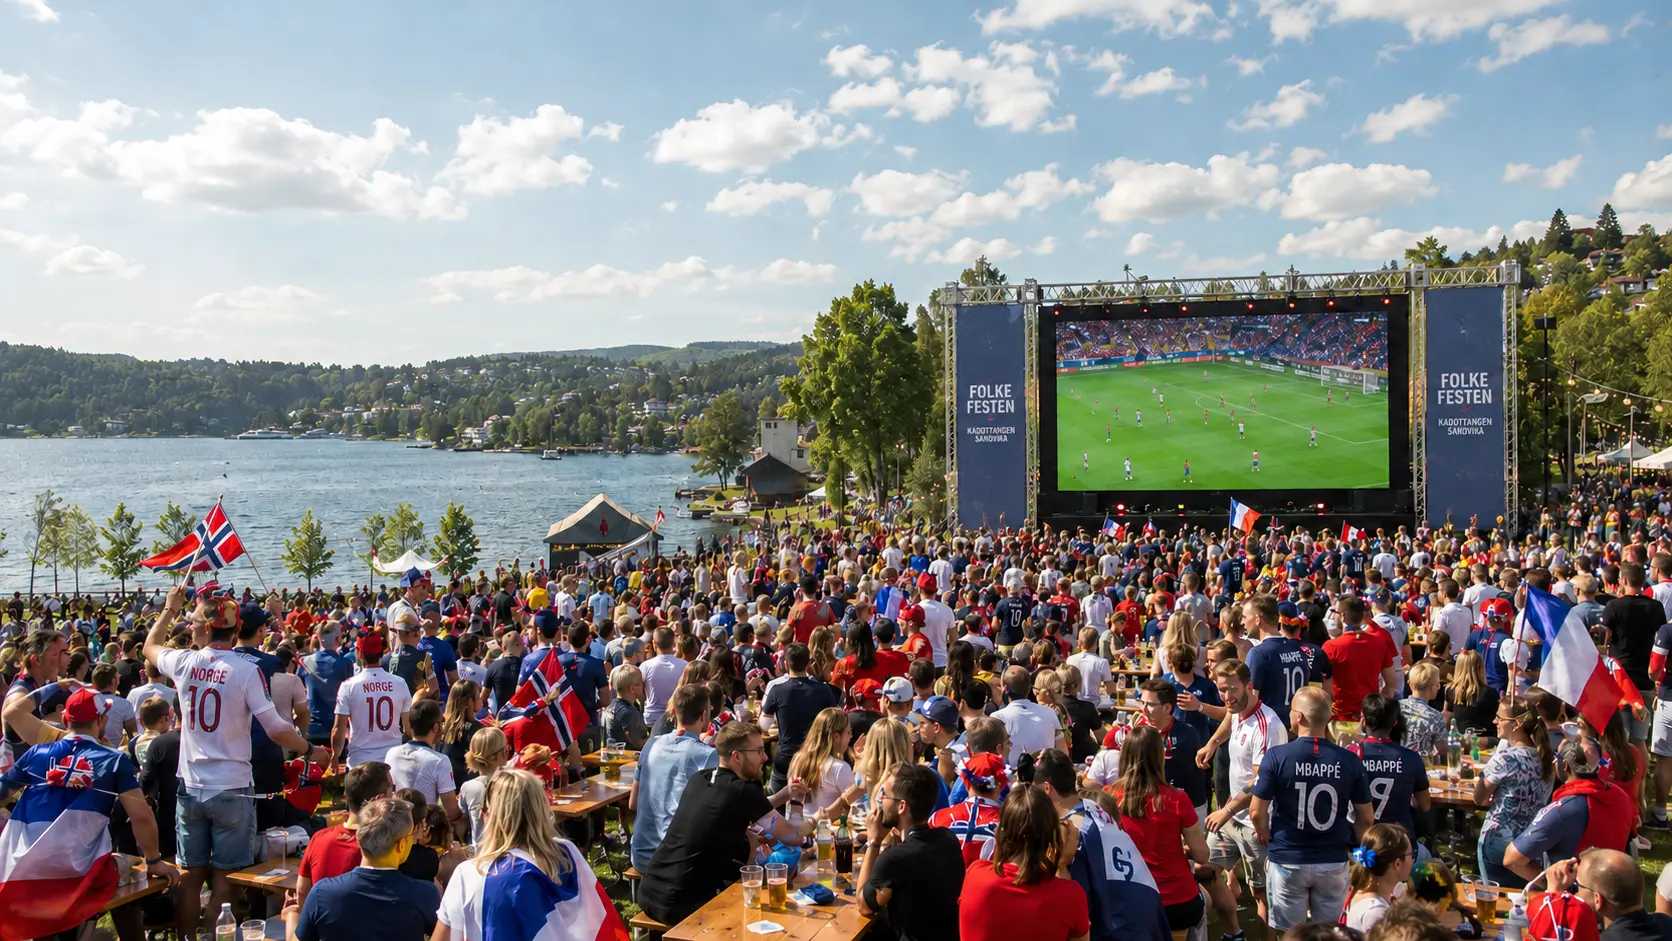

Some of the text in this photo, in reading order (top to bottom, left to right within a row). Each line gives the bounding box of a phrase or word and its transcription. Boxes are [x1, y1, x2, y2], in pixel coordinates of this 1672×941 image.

[1441, 372, 1488, 388] FOLKE
[970, 384, 1012, 399] FOLKE
[1437, 389, 1492, 405] FESTEN
[967, 400, 1015, 414] FESTEN
[1438, 417, 1492, 426] KADOTTANGEN
[190, 667, 228, 685] NORGE
[363, 681, 393, 693] NORGE
[188, 685, 222, 733] 10
[366, 695, 394, 733] 10
[1295, 761, 1341, 779] MBAPPÉ
[1294, 781, 1339, 832] 10
[1369, 777, 1395, 820] 9
